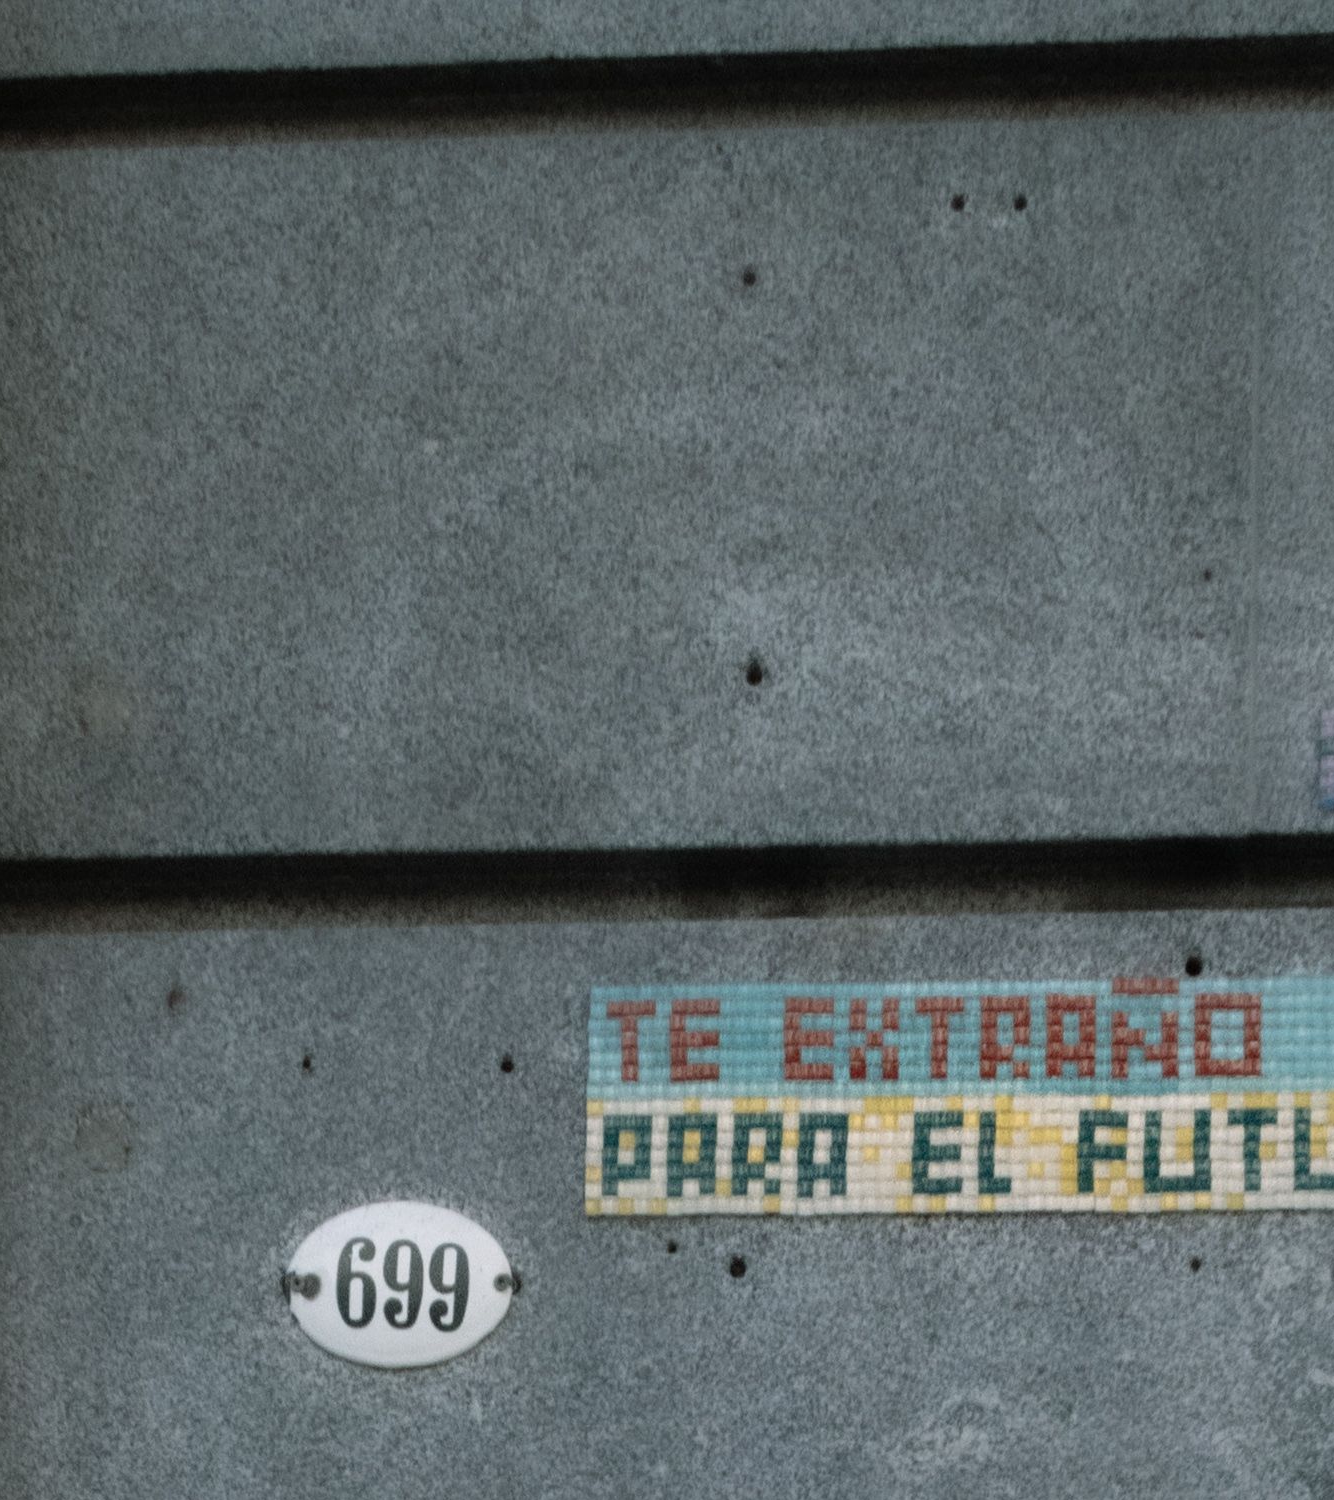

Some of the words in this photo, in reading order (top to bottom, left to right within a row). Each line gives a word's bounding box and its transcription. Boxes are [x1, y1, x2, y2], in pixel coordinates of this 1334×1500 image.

[606, 998, 720, 1082] TE
[783, 976, 1262, 1081] EXTRAÑO
[601, 1112, 848, 1198] PARA
[911, 1109, 1012, 1195] EL
[335, 1236, 470, 1333] 699
